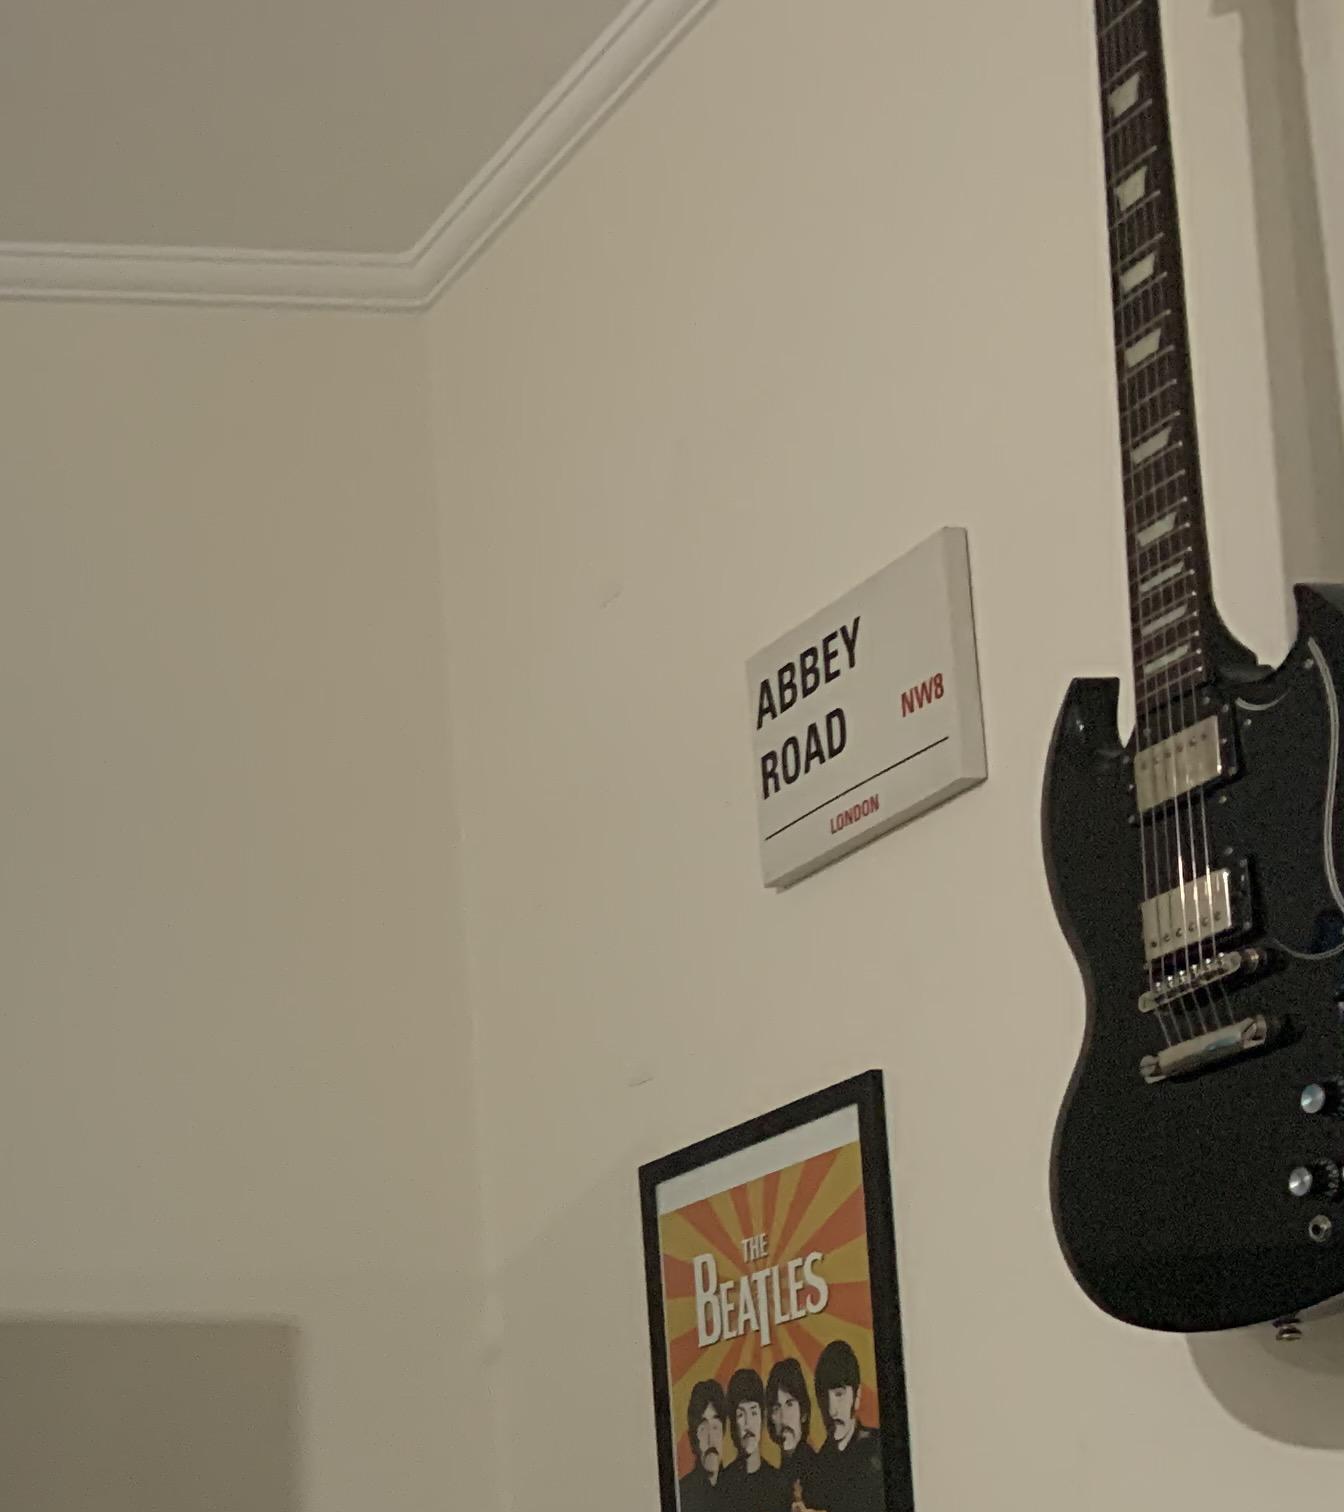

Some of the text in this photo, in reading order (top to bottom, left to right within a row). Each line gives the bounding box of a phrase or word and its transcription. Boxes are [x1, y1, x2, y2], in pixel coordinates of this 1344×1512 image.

[756, 615, 861, 731] ABBEY
[900, 672, 945, 718] NW8
[760, 706, 848, 801] ROAD
[829, 792, 880, 835] LONDON
[740, 1232, 769, 1264] THE
[692, 1250, 830, 1349] BEATLES
